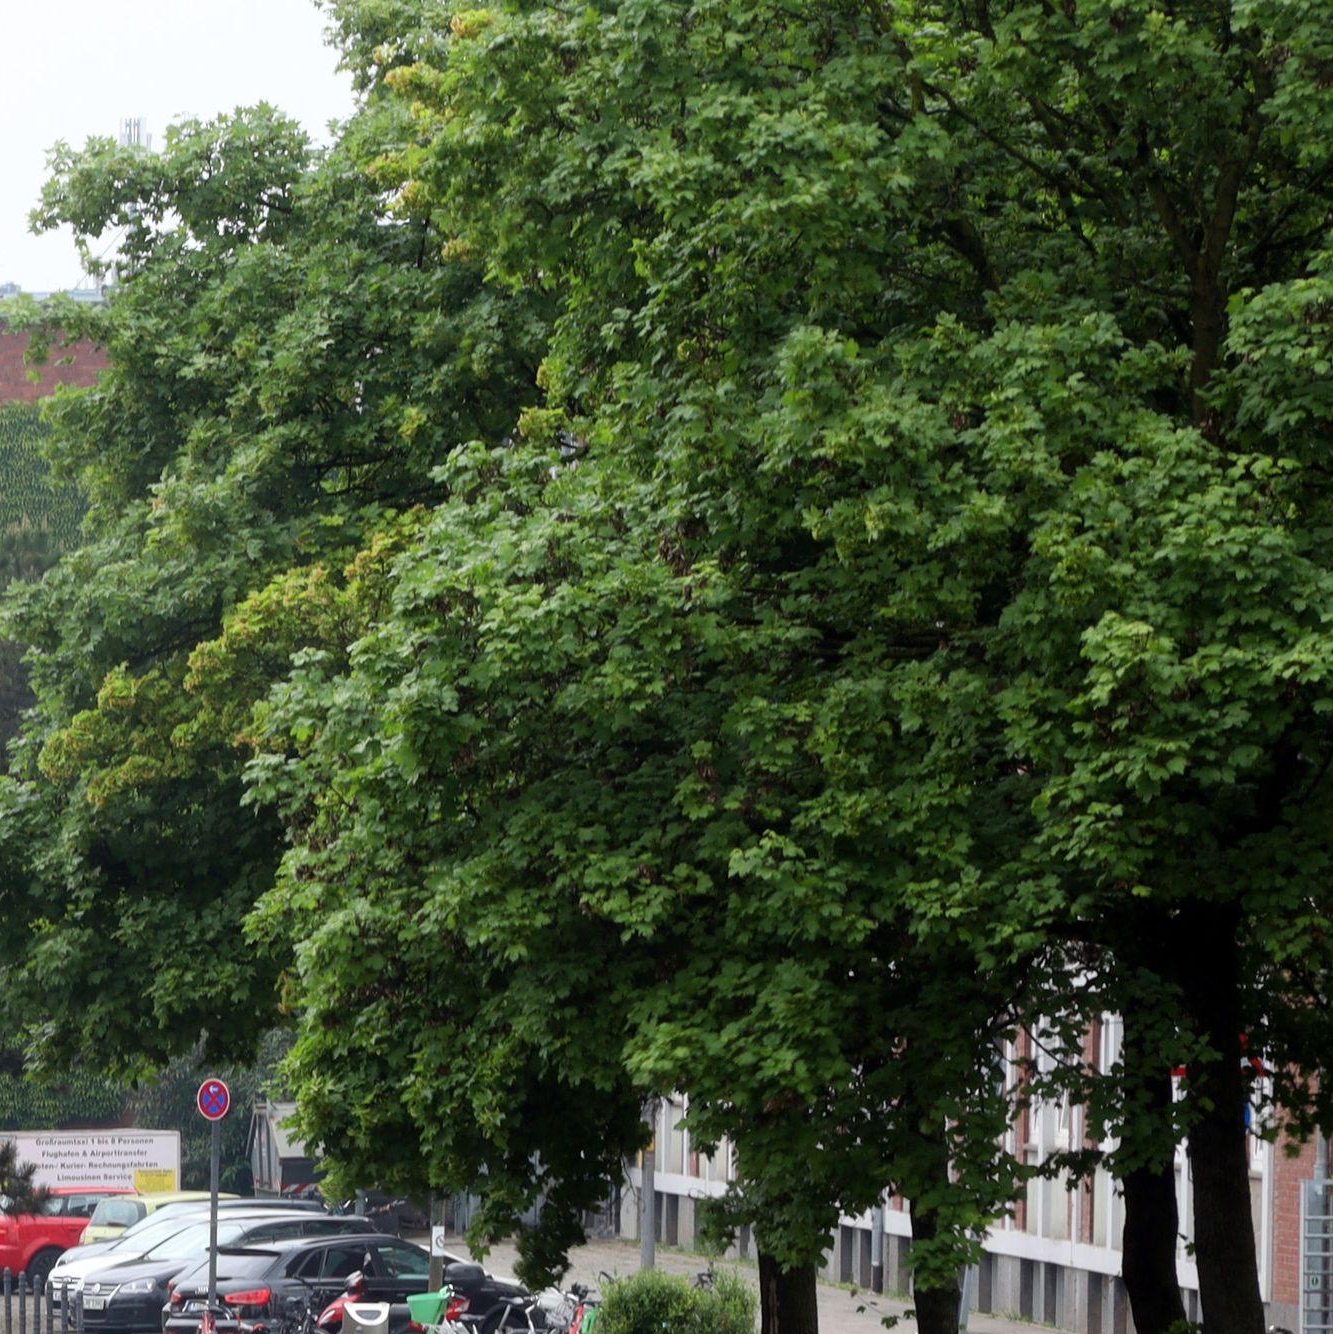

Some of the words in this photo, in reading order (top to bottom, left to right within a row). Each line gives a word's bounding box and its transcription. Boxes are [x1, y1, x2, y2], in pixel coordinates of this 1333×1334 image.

[35, 1138, 88, 1146] Großraumtaxi
[117, 1137, 154, 1145] Personen
[42, 1150, 80, 1158] Flughafen
[90, 1149, 147, 1158] Airporttransfer
[88, 1161, 158, 1171] Rechnungsfahrten
[103, 1173, 132, 1181] Service
